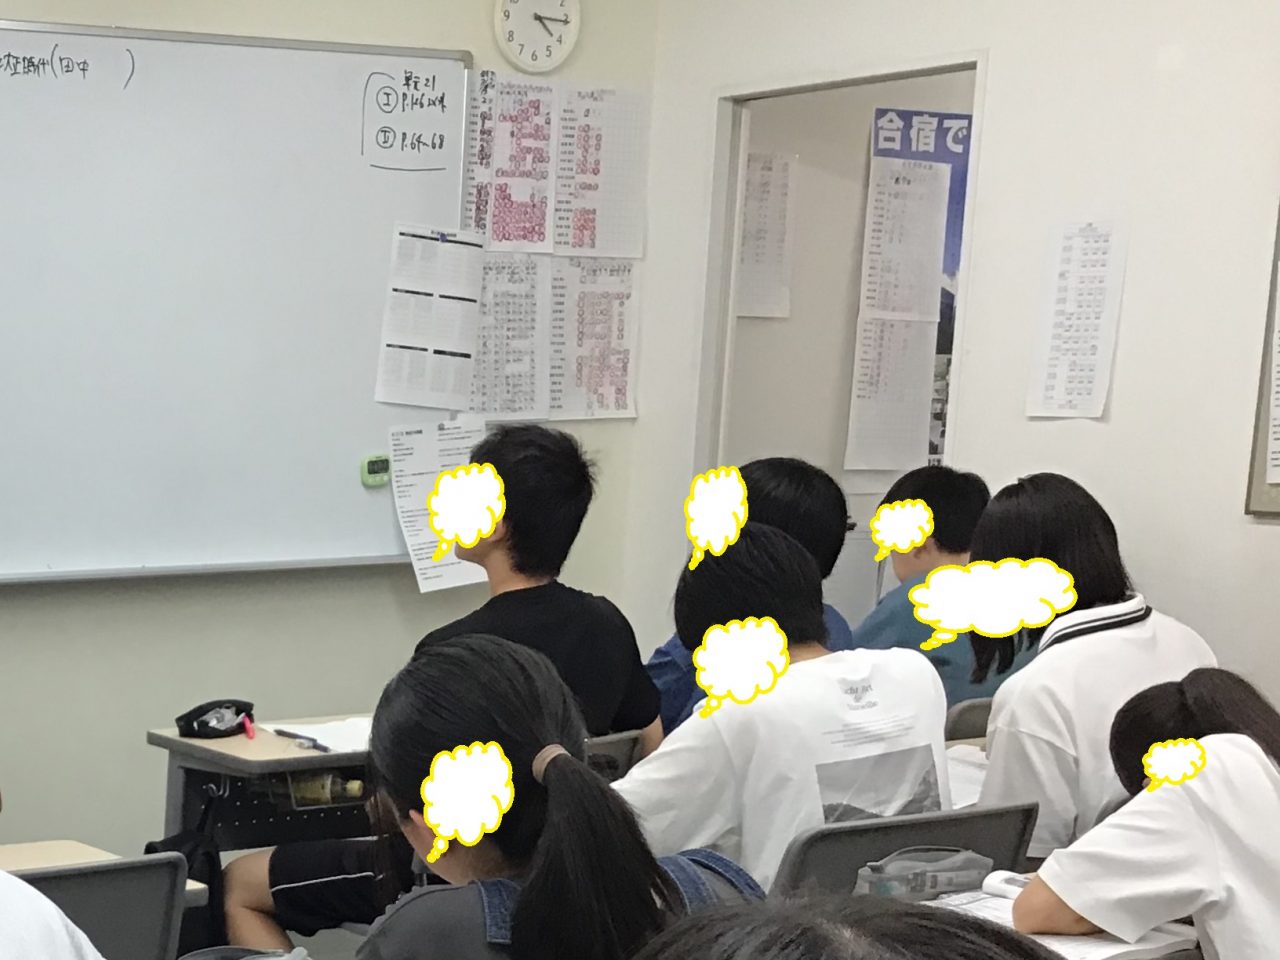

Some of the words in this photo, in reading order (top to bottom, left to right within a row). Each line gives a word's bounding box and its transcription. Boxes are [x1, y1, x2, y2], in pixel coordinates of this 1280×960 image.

[503, 9, 510, 21] 9
[507, 30, 514, 42] 8
[556, 34, 562, 45] 4
[518, 43, 525, 56] 7
[531, 50, 538, 61] 6
[545, 45, 552, 57] 5
[876, 111, 969, 153] 合宿で
